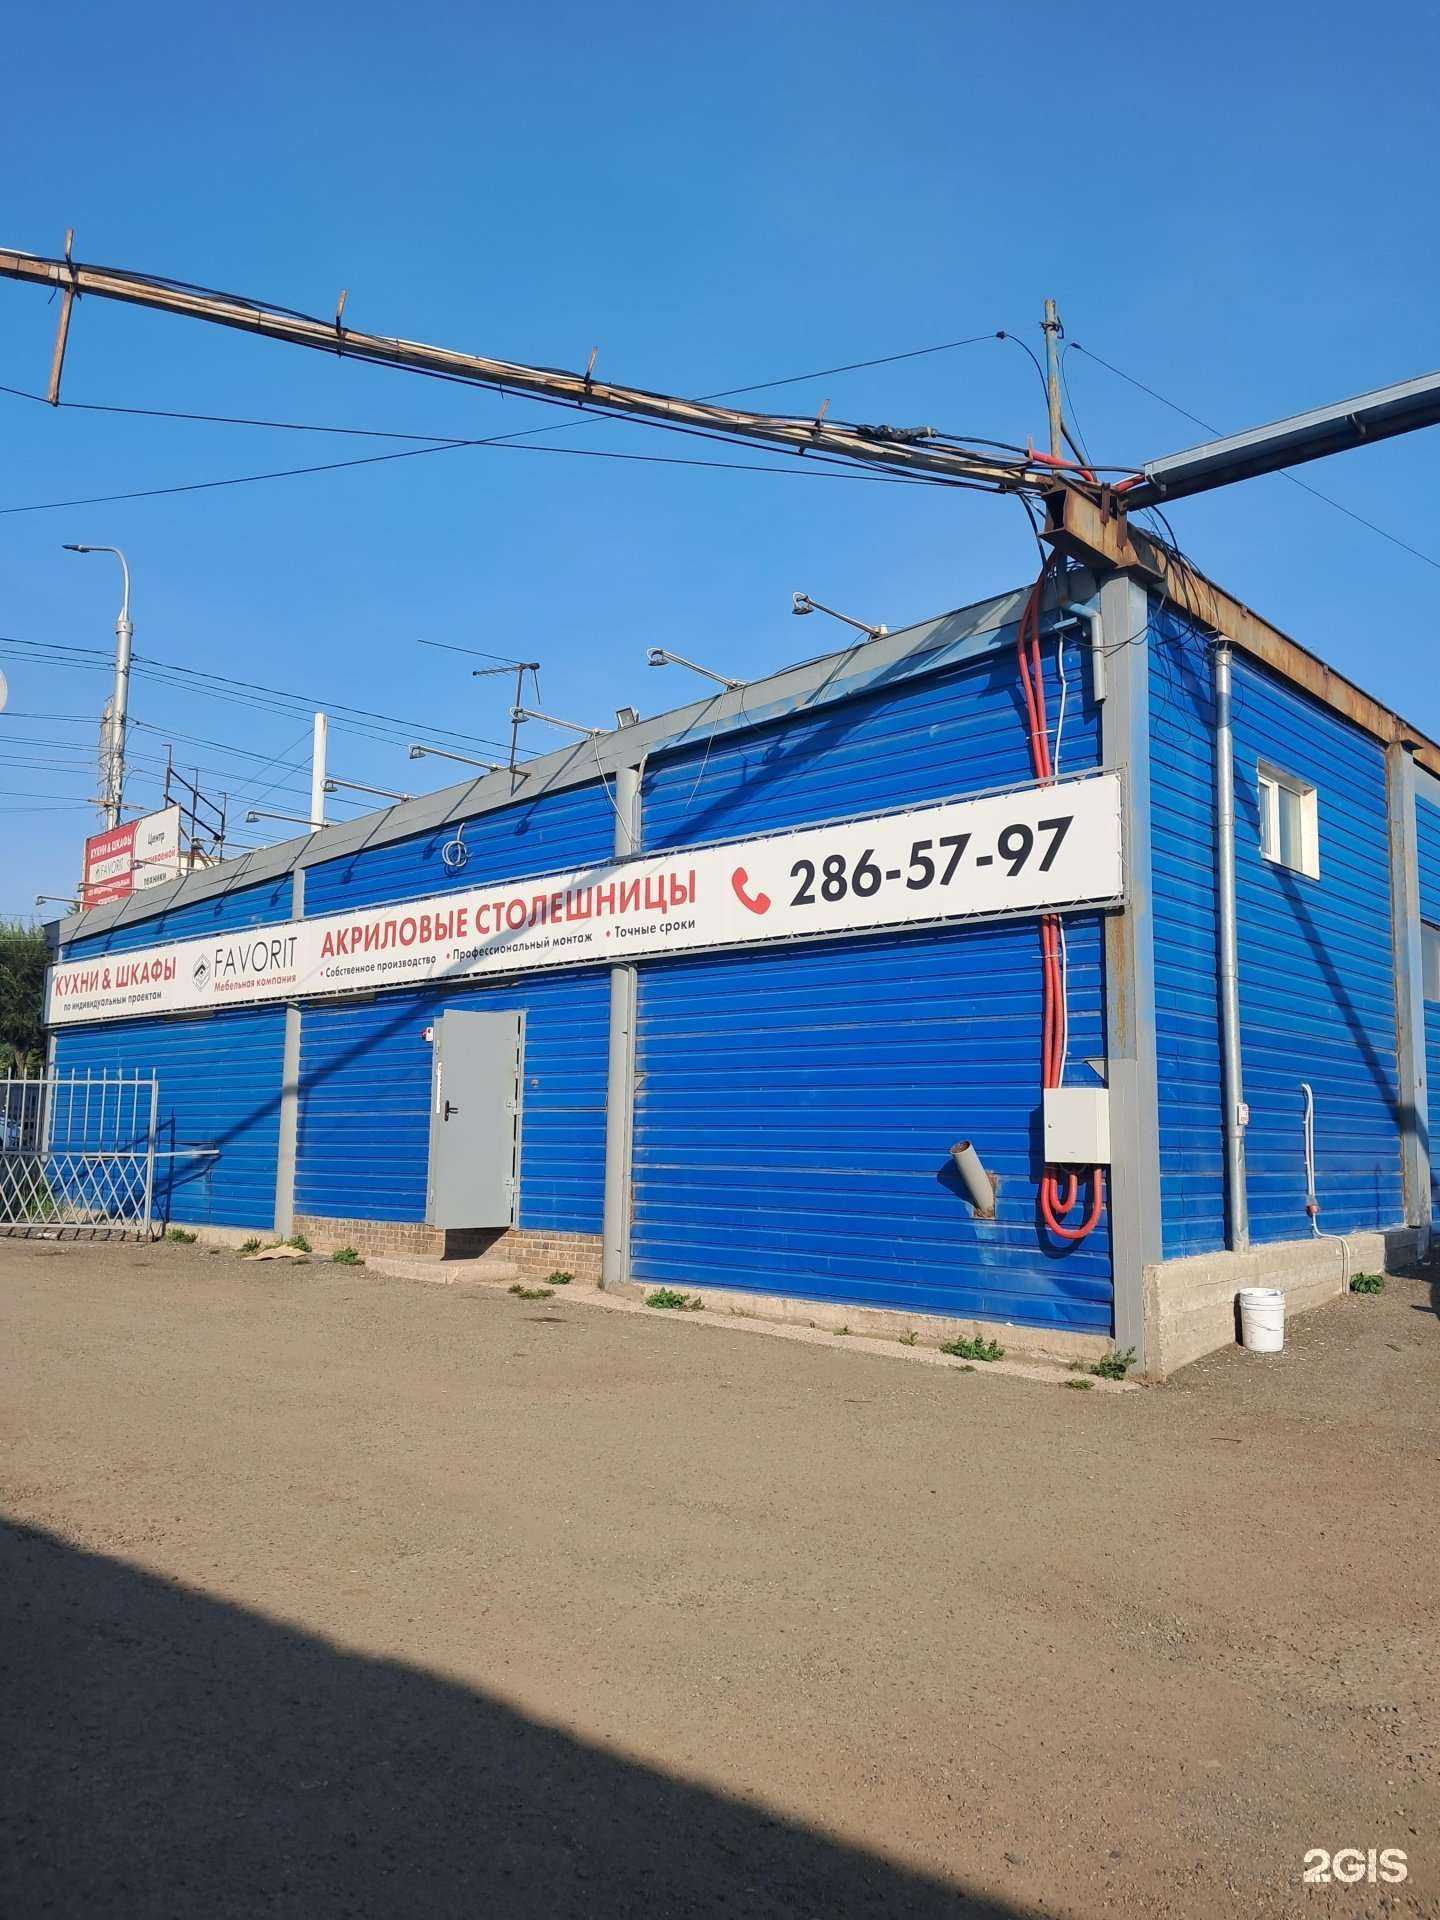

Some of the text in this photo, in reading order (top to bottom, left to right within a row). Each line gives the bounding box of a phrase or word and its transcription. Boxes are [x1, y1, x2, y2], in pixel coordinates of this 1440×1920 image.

[789, 815, 1074, 907] 286-57-97
[320, 869, 696, 959] АКРИЛОВЫЕ СТОЛЕШНИЦЫ
[614, 918, 696, 938] Точные сроки
[214, 936, 298, 978] FAVORIT
[452, 932, 593, 962] Профессиональный монтаж
[55, 956, 177, 997] КУХНИ & ШКАФЫ
[325, 955, 437, 979] Собственное производство
[214, 974, 297, 993] Мебельная компания
[63, 991, 162, 1012] по индивидуальным проектам
